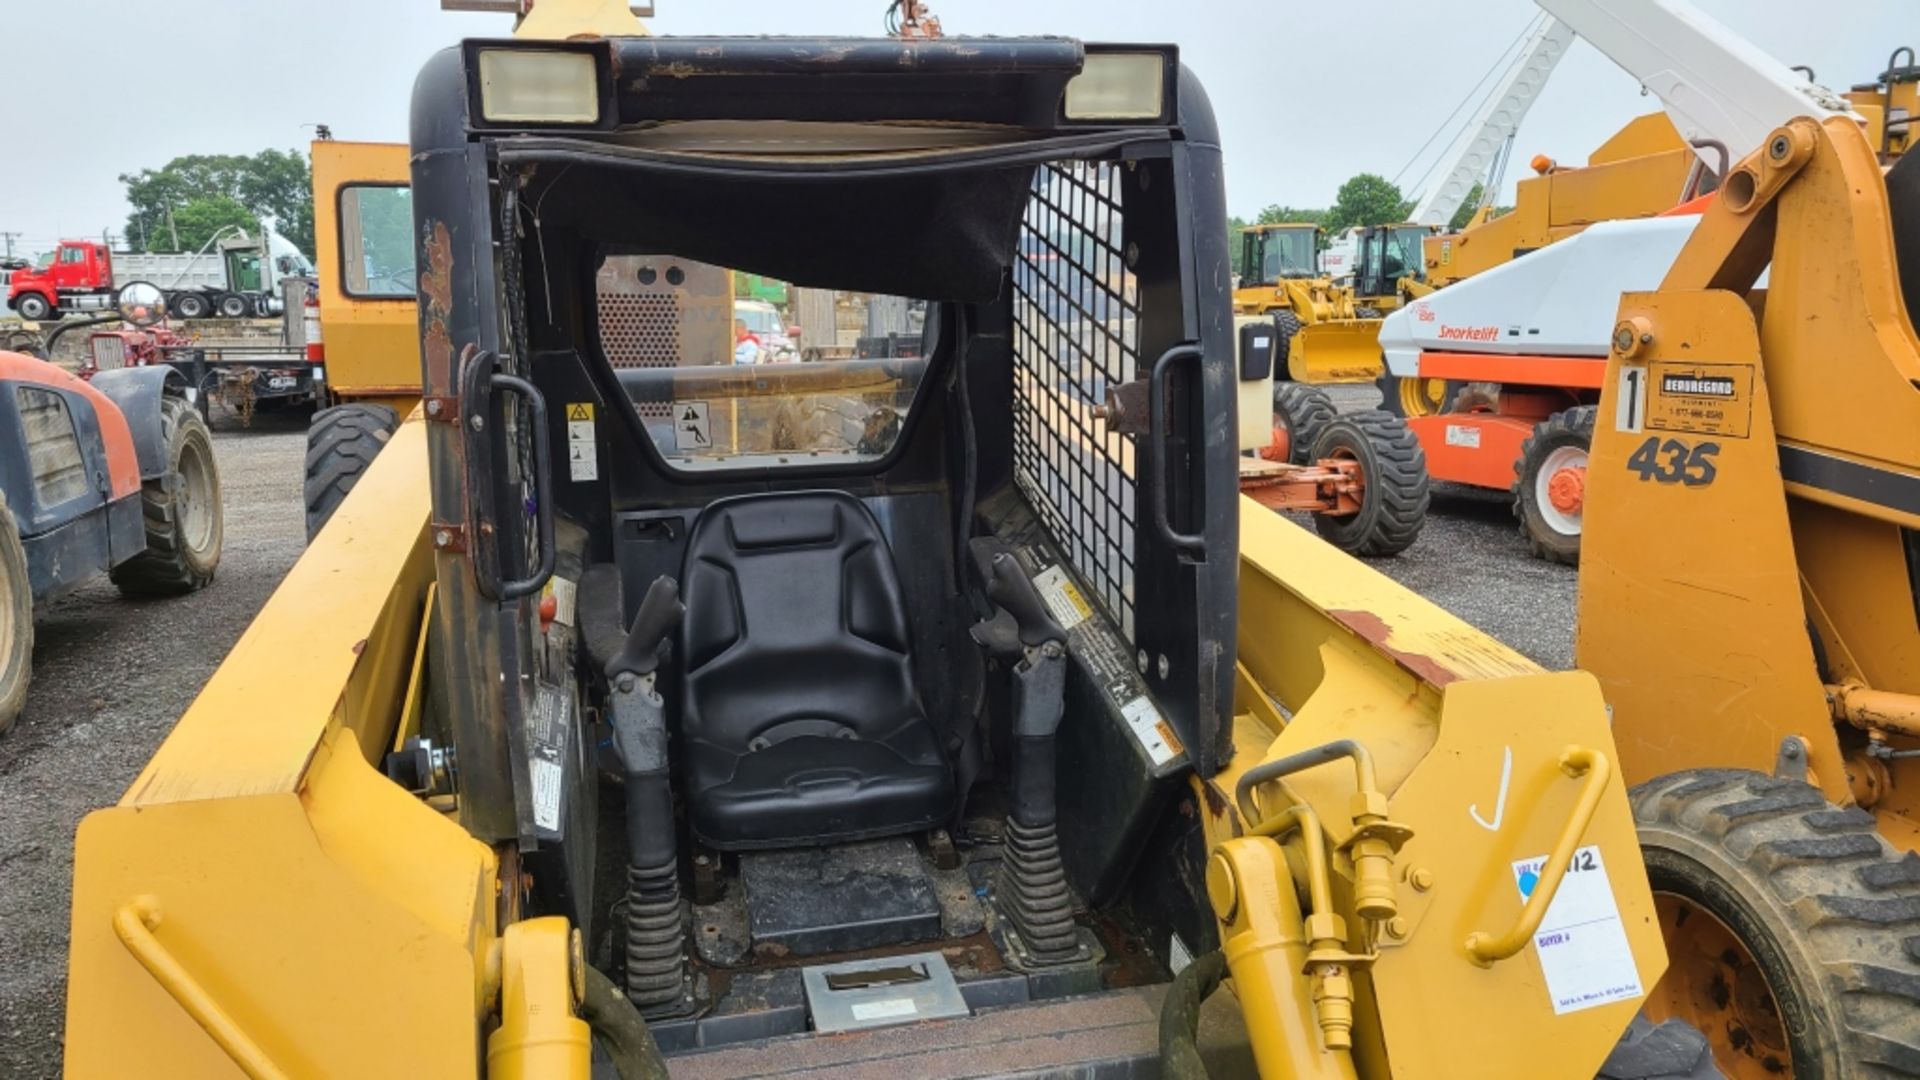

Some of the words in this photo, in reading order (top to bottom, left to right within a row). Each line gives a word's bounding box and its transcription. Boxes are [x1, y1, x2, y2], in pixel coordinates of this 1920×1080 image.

[1438, 324, 1499, 341] Snorkelift
[1627, 370, 1638, 429] 1
[1665, 379, 1733, 394] BEAUREGARD
[1626, 436, 1721, 486] 435
